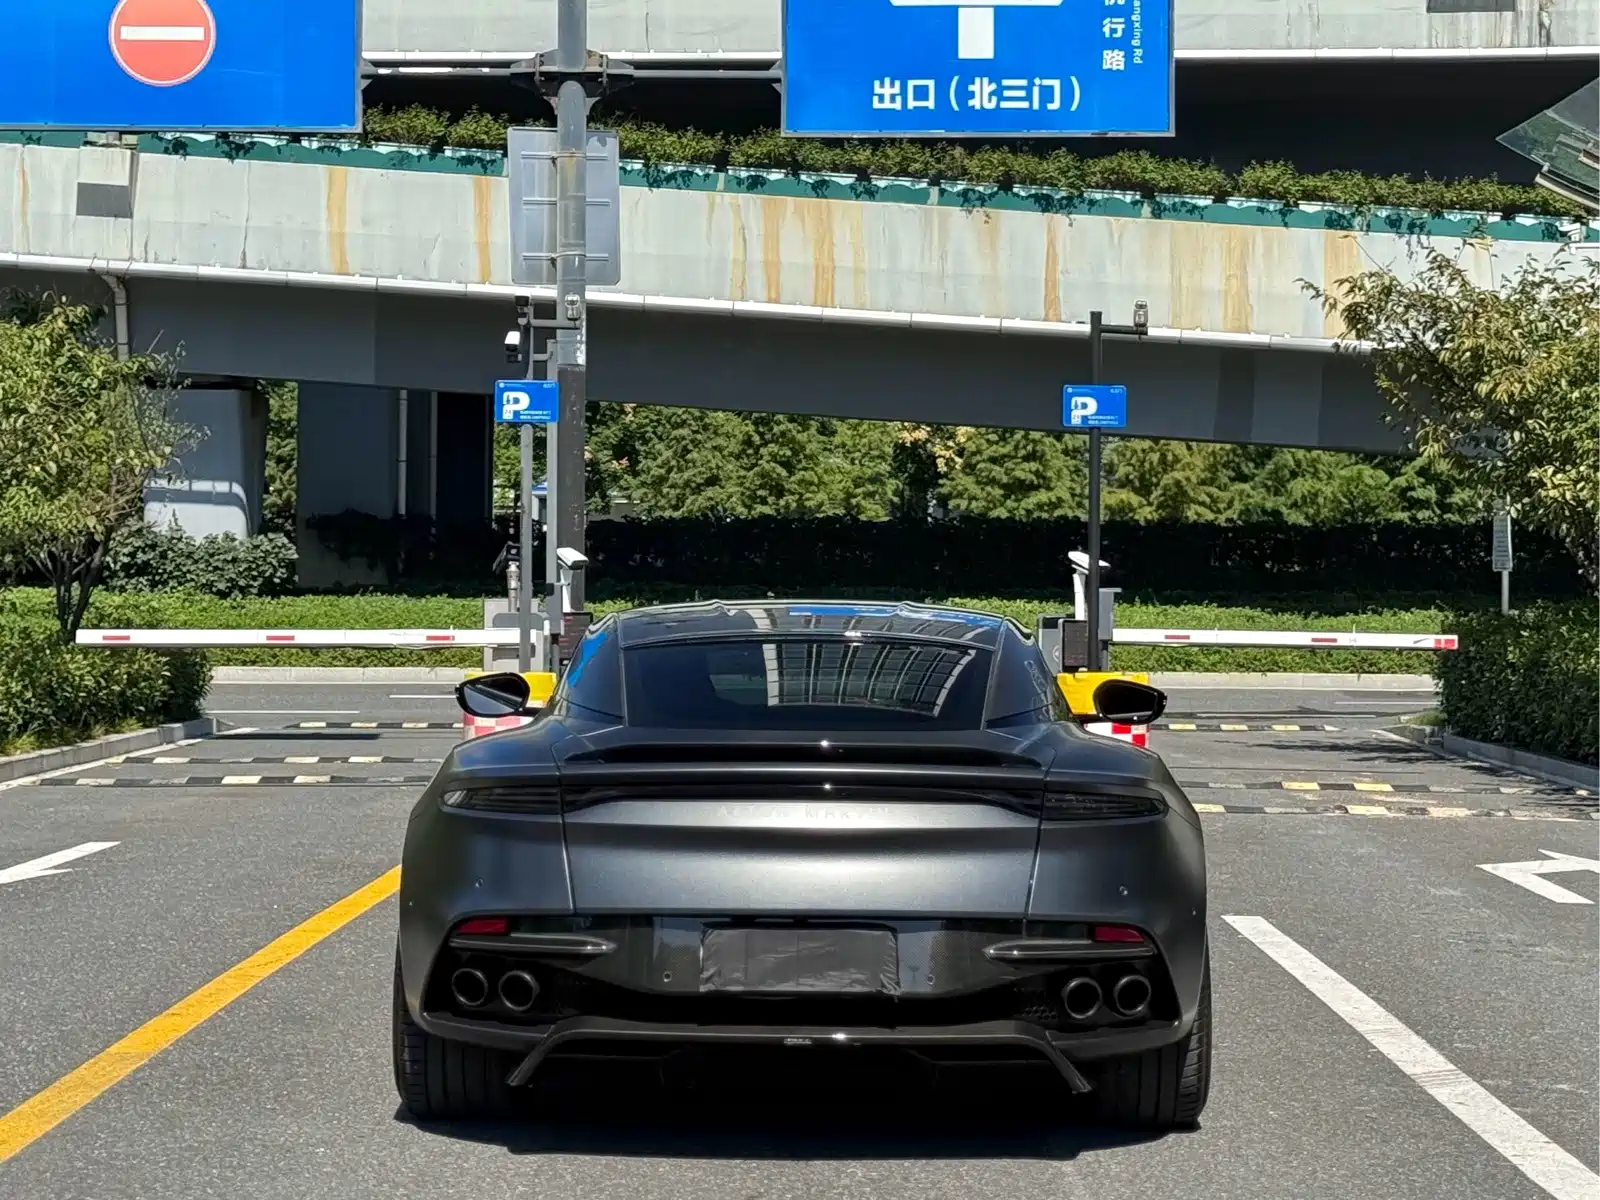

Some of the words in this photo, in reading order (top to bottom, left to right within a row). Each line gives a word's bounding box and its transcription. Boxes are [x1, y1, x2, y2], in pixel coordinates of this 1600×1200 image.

[1102, 0, 1126, 71] 行路
[1132, 48, 1144, 64] Rd
[872, 75, 1081, 112] 出口（北三门）
